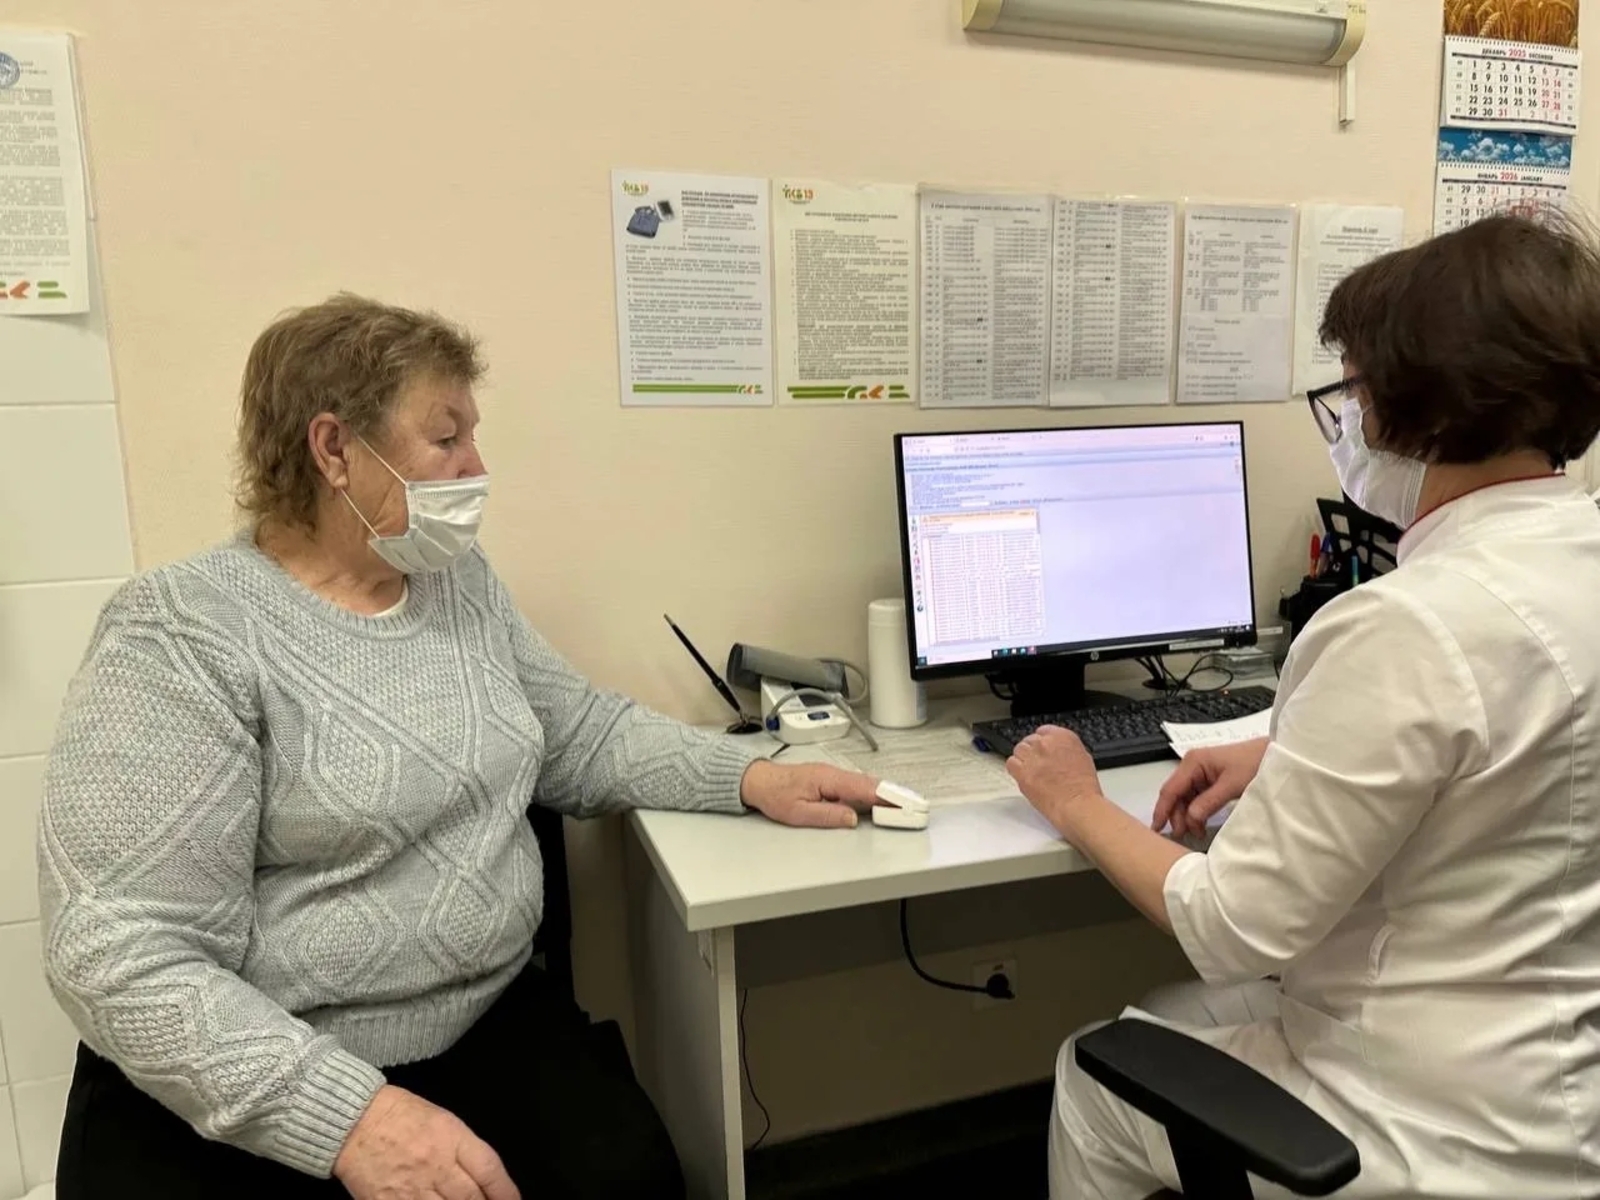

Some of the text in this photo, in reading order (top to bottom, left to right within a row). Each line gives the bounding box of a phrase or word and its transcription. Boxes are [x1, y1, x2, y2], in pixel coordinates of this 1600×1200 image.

[1509, 49, 1526, 58] 2025
[1500, 74, 1508, 82] 10
[1514, 75, 1521, 83] 11
[1470, 84, 1478, 92] 15
[1484, 85, 1493, 93] 16
[1500, 86, 1508, 94] 17
[1514, 86, 1522, 94] 18
[1529, 88, 1536, 96] 19
[1483, 97, 1492, 105] 23
[1499, 97, 1508, 105] 24
[1514, 98, 1522, 106] 25
[1528, 99, 1537, 107] 26
[1554, 102, 1560, 110] 28
[1469, 107, 1477, 115] 29
[1500, 172, 1517, 180] 2026
[1477, 186, 1485, 194] 30
